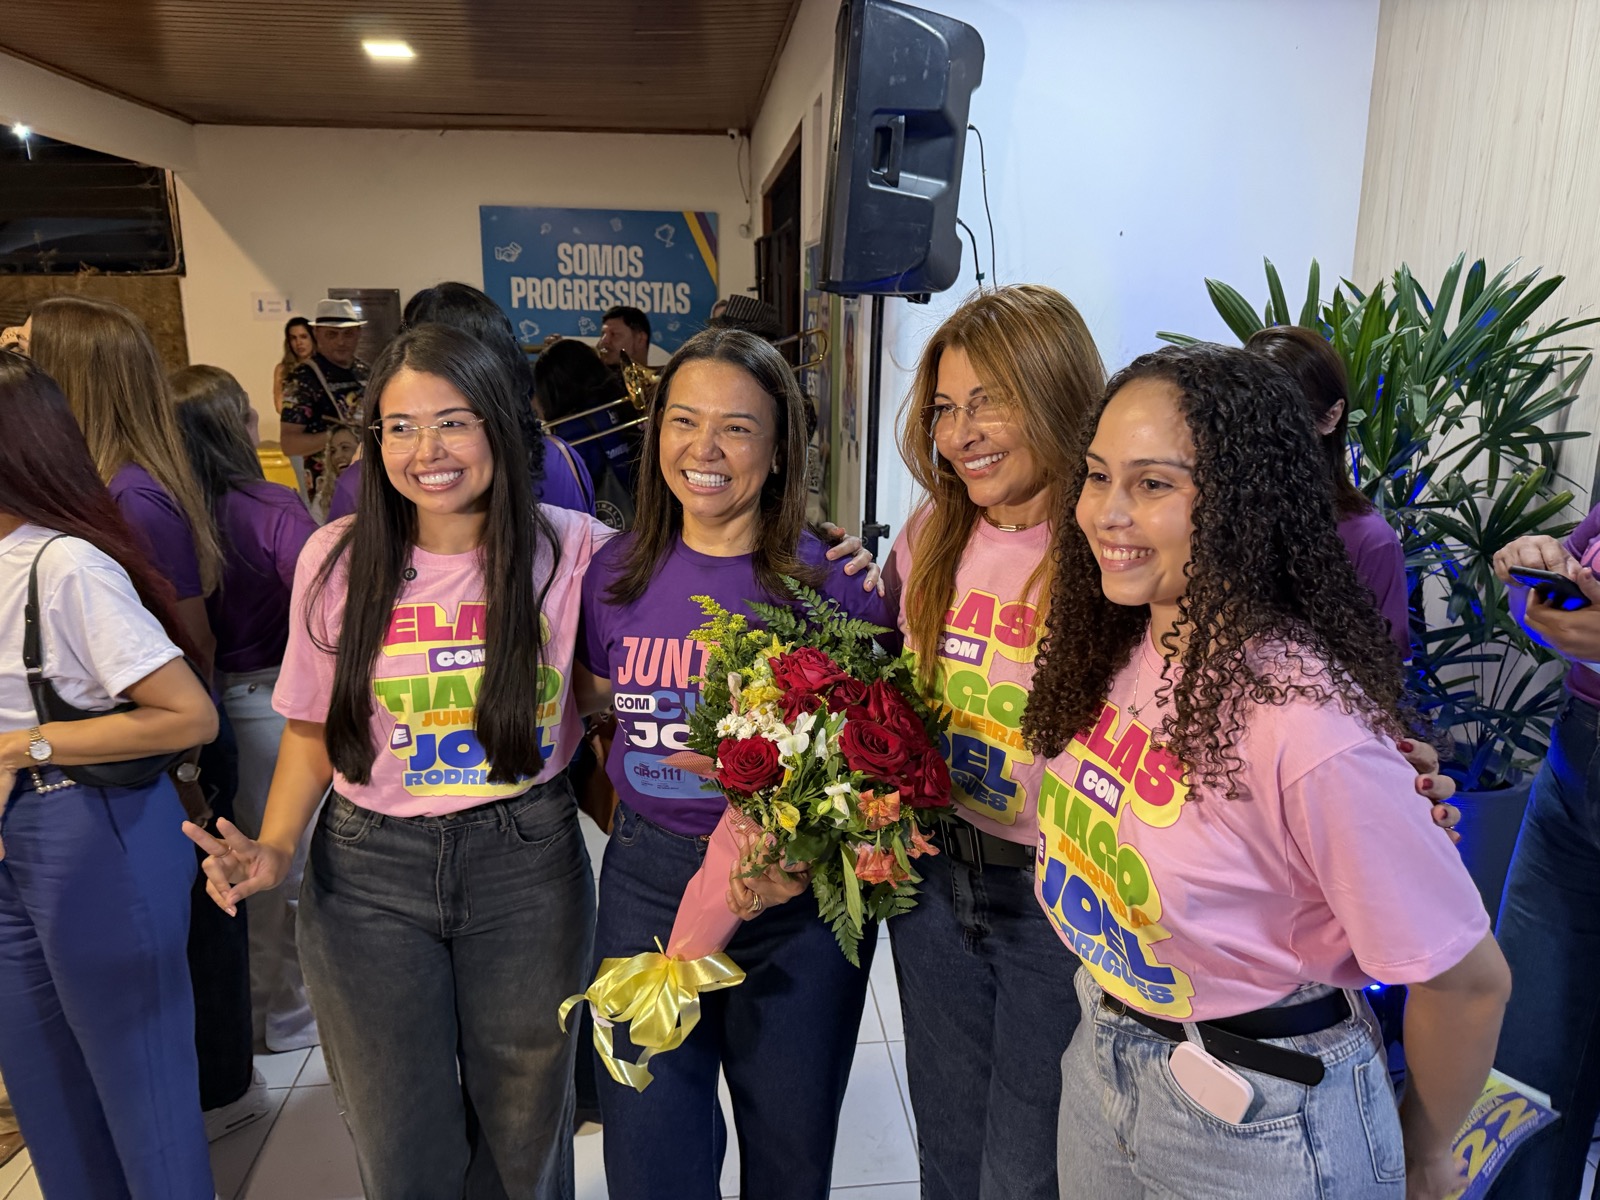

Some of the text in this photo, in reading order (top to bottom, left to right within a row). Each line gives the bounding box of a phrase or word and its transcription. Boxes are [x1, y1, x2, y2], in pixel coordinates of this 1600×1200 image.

[557, 243, 644, 278] SOMOS
[510, 277, 691, 314] PROGRESSISTAS
[384, 605, 540, 646] ELA
[943, 592, 1040, 648] AS
[618, 637, 720, 690] JUNT
[374, 666, 560, 713] TIAO
[617, 697, 650, 711] COM
[392, 726, 555, 772] E JOL
[939, 733, 1017, 798] EL
[661, 767, 682, 781] 111
[1083, 769, 1119, 808] COM
[1042, 857, 1177, 985] JOEL
[1452, 1098, 1537, 1181] 22
